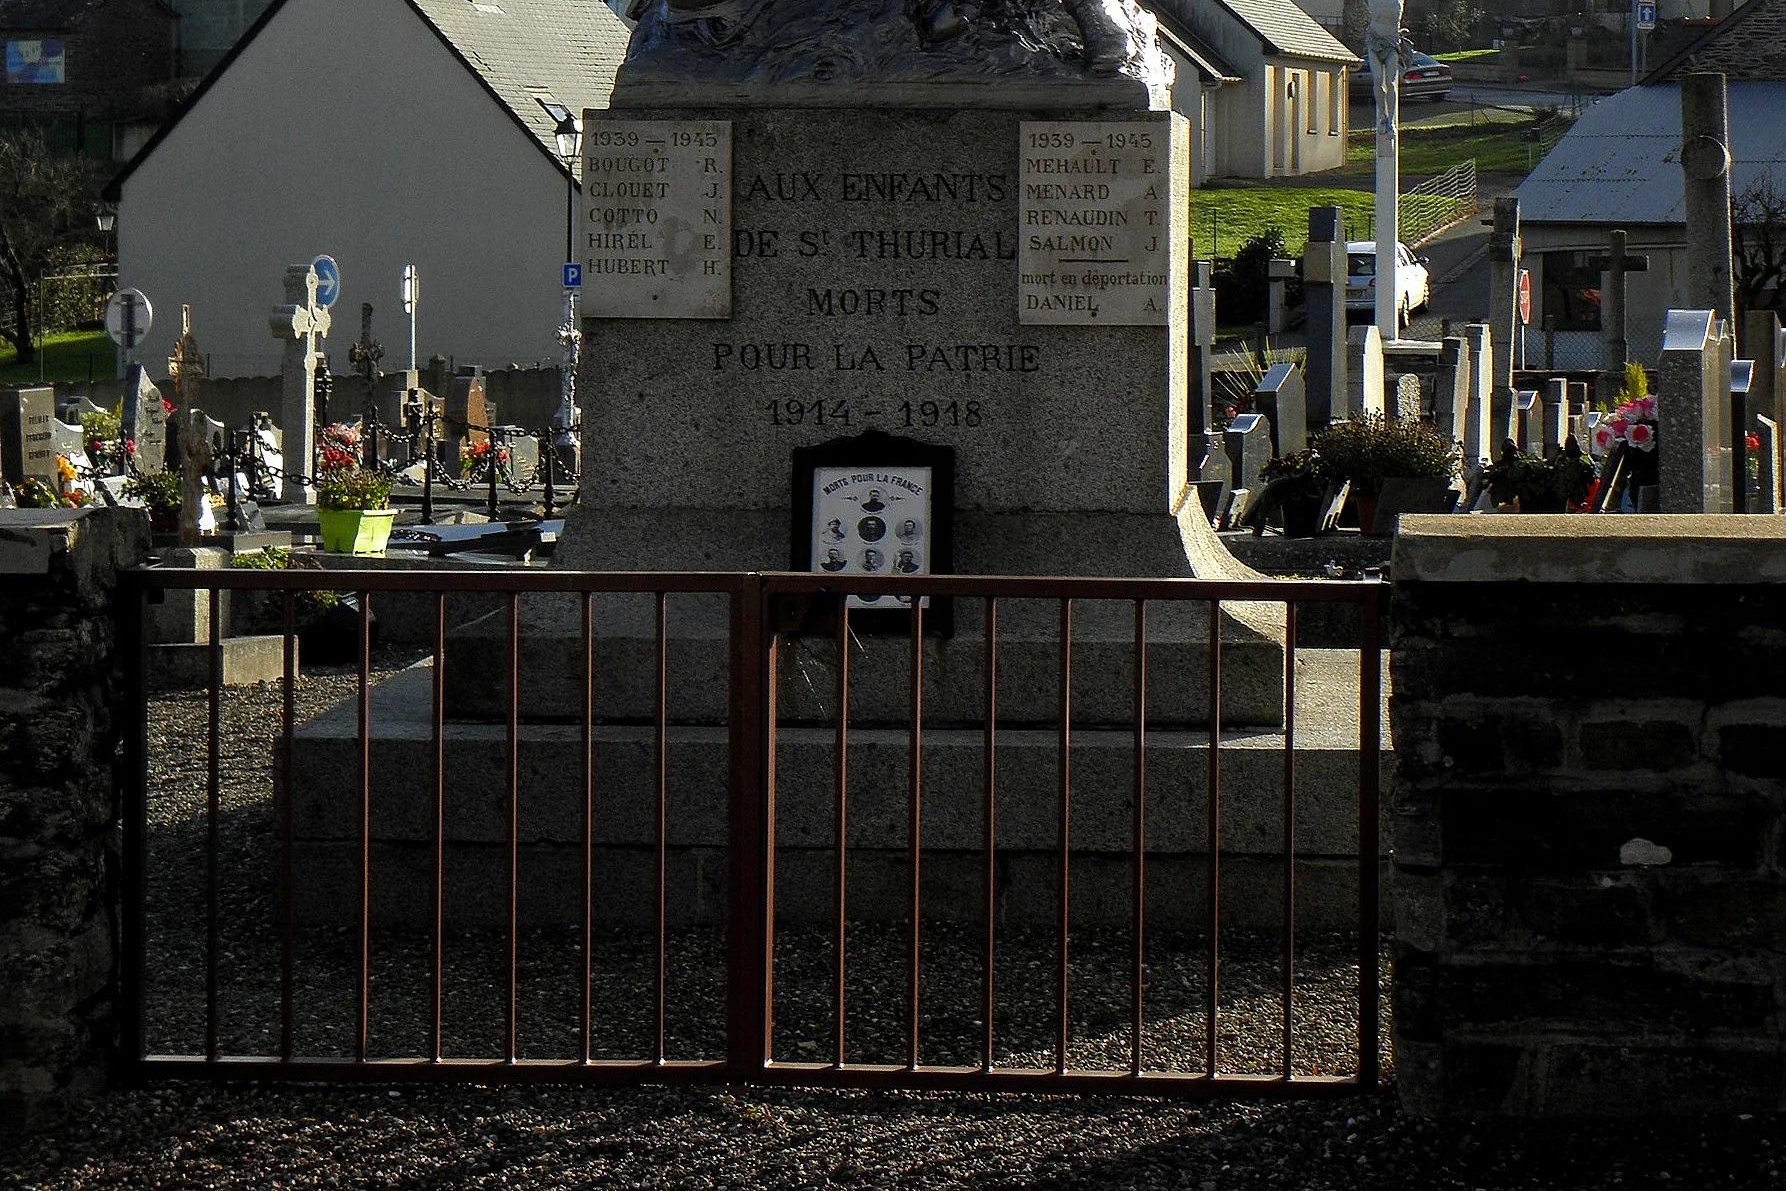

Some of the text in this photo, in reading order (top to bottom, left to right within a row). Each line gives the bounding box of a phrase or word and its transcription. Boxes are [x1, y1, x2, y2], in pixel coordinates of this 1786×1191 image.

[591, 132, 639, 147] 1939
[671, 132, 717, 147] 1945
[1029, 133, 1075, 148] 1939
[1107, 133, 1152, 148] 1945
[588, 157, 723, 174] BOUGOT R.
[1026, 159, 1162, 174] MEHAULT E.
[589, 182, 723, 199] CLOUET J.
[748, 173, 1008, 202] AUX ENFANTS
[1026, 184, 1163, 200] MENARD A.
[589, 207, 722, 224] COTTO N.
[1027, 210, 1161, 227] RENAUDIN T.
[703, 234, 722, 250] E.
[733, 229, 778, 258] DE
[851, 230, 1016, 260] THURIAL
[1029, 235, 1113, 252] SALMON
[568, 267, 578, 283] P
[588, 258, 722, 276] HUBERT H.
[1022, 270, 1058, 285] mort
[1061, 273, 1077, 285] en
[807, 288, 941, 316] MORTS
[1027, 295, 1162, 311] DANIEL A.
[712, 343, 1042, 373] POUR LA PATRIE
[765, 399, 851, 427] 1914
[897, 400, 982, 428] 1918
[822, 473, 924, 496] MORTS POUR LA FRANCE
